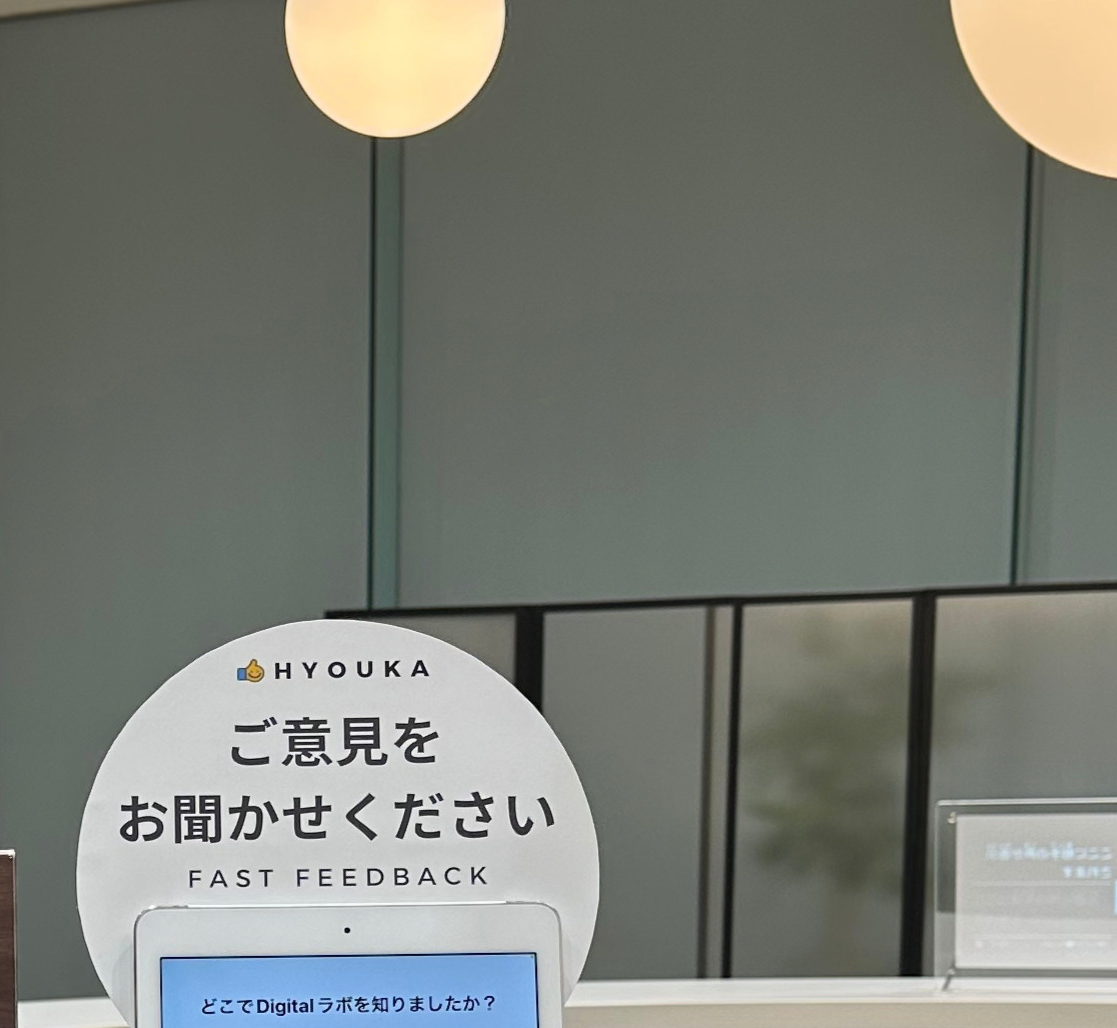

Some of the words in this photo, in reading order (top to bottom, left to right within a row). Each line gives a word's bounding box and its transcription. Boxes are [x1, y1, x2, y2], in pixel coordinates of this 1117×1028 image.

[274, 659, 430, 680] HYOUKA
[231, 716, 439, 767] ご意見を
[119, 791, 555, 845] お聞かせください
[189, 869, 274, 889] FAST
[296, 866, 487, 887] FEEDBACK
